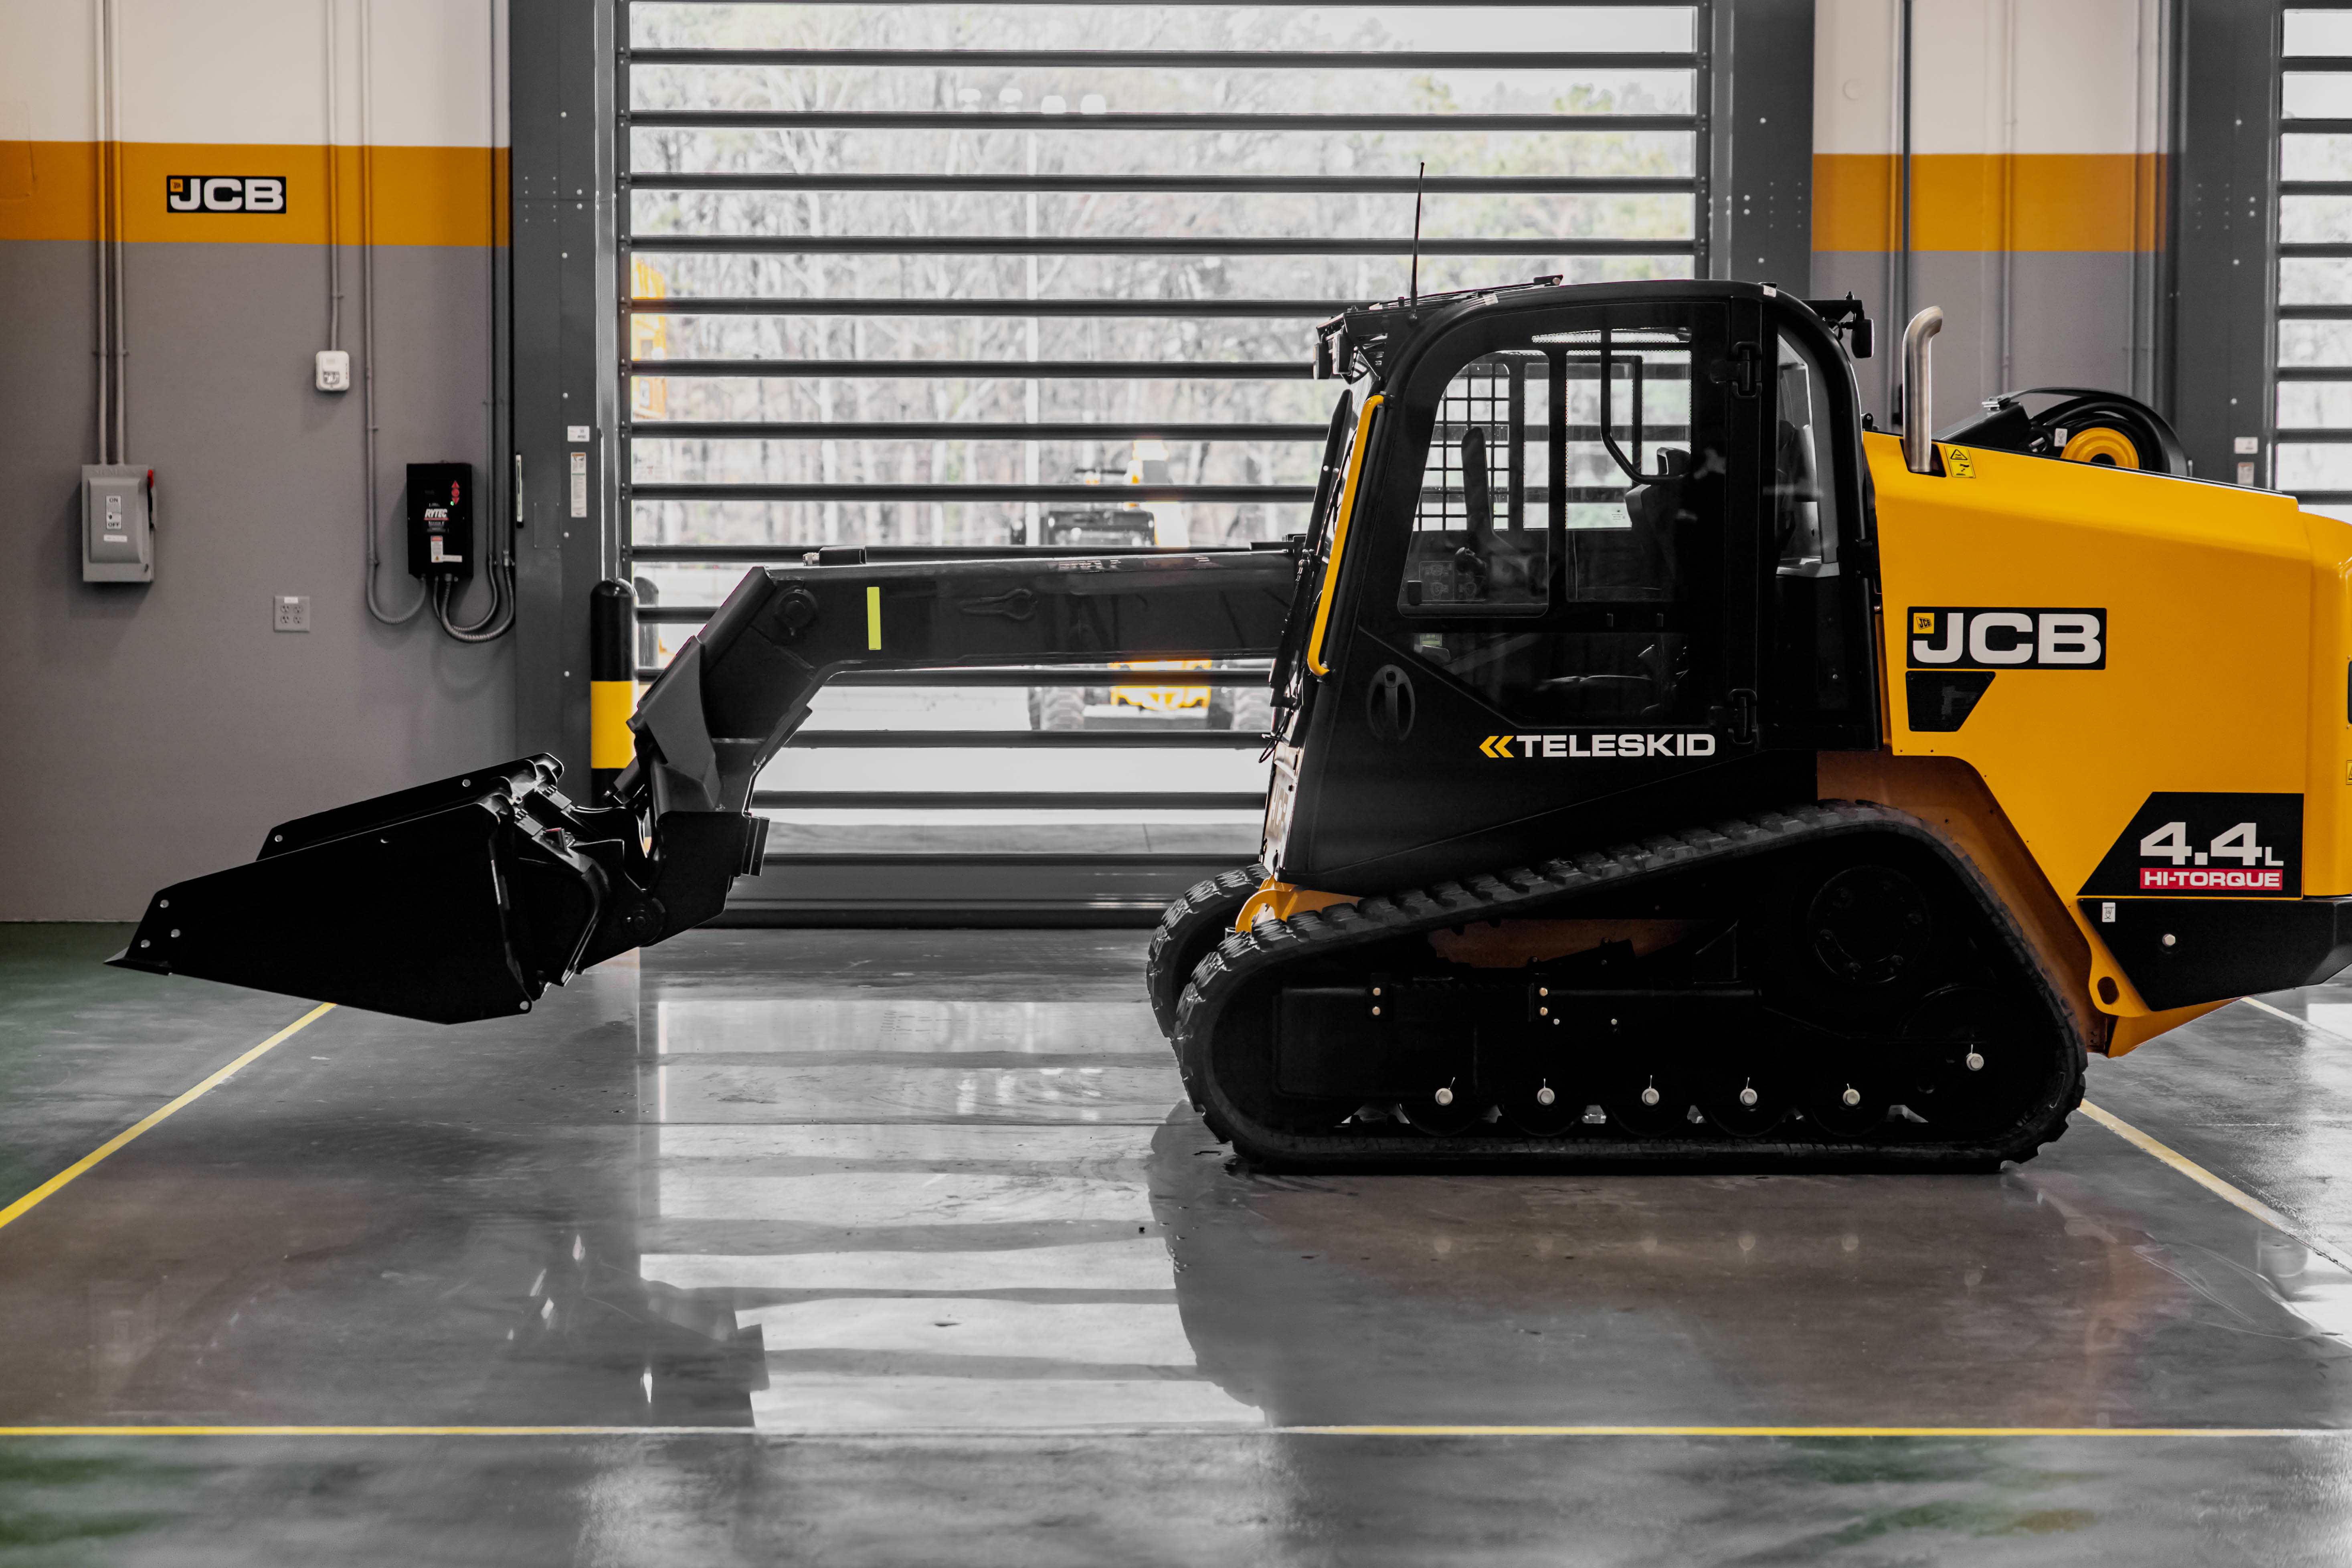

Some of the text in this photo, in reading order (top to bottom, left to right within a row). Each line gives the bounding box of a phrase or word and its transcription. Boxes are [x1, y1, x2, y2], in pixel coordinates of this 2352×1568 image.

[170, 178, 283, 210] JCB
[425, 508, 448, 518] RYTEC
[1918, 618, 1931, 628] JCB
[1913, 612, 2101, 664] JCB
[1516, 734, 1715, 758] TELESKID
[2145, 871, 2280, 887] HI-TORQUE
